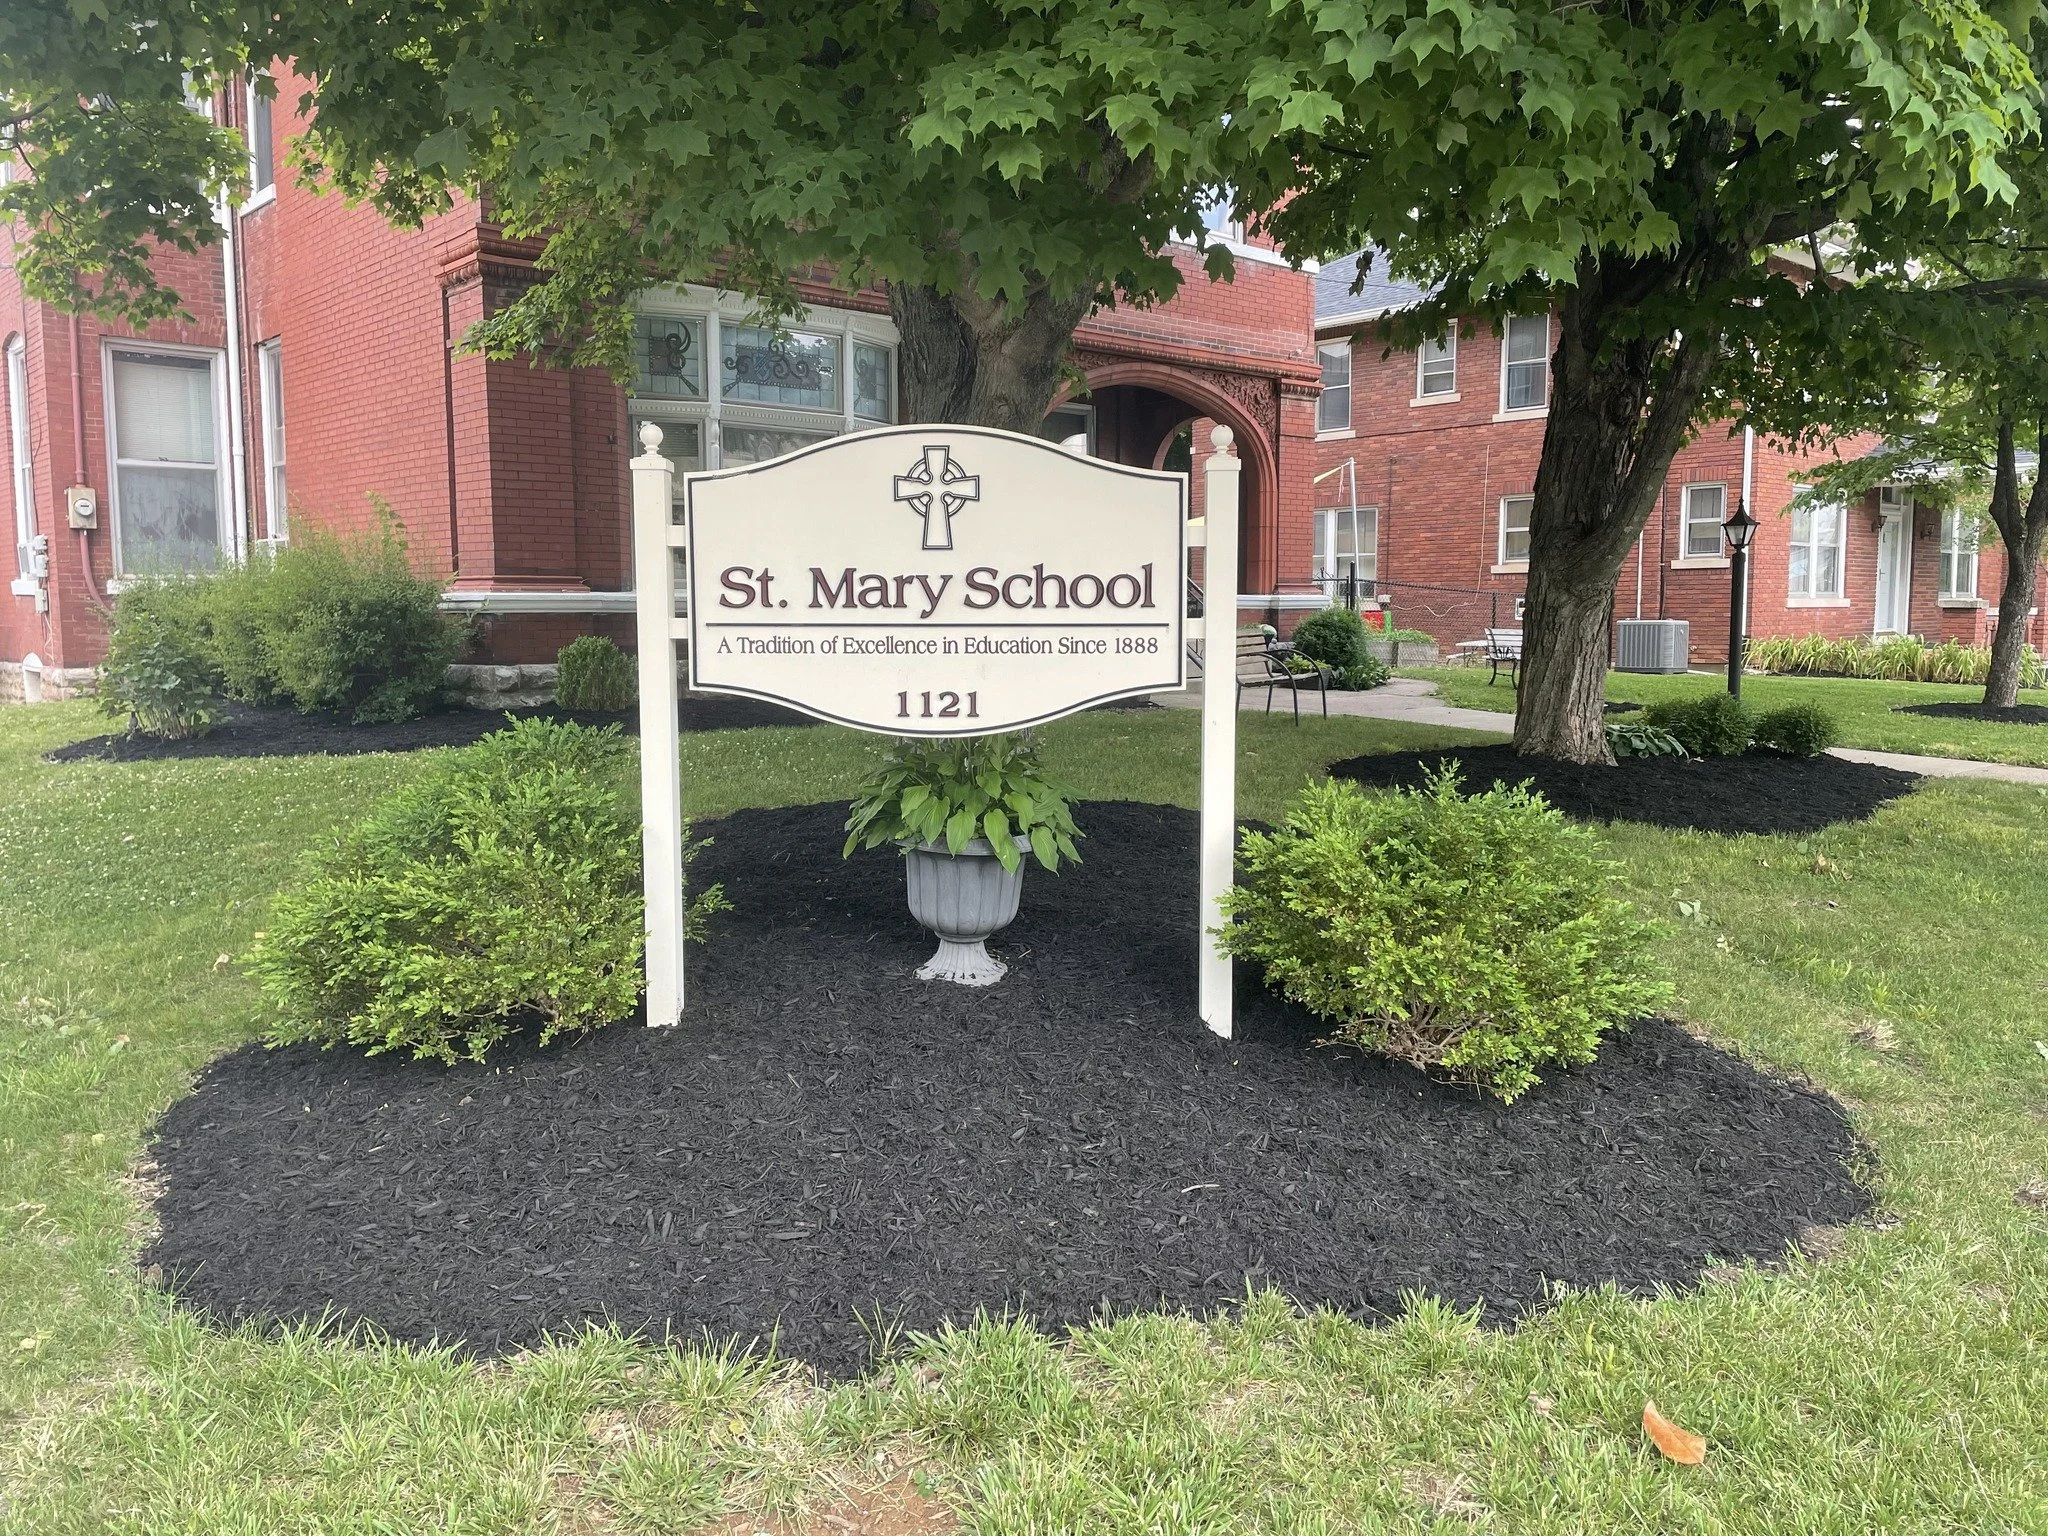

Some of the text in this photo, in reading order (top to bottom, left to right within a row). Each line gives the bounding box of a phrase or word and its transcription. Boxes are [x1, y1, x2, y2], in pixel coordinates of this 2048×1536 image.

[719, 562, 1156, 619] St. Mary School
[717, 635, 1158, 655] A Tradition of Excellence in Education Since 1888
[897, 691, 980, 718] 1121
